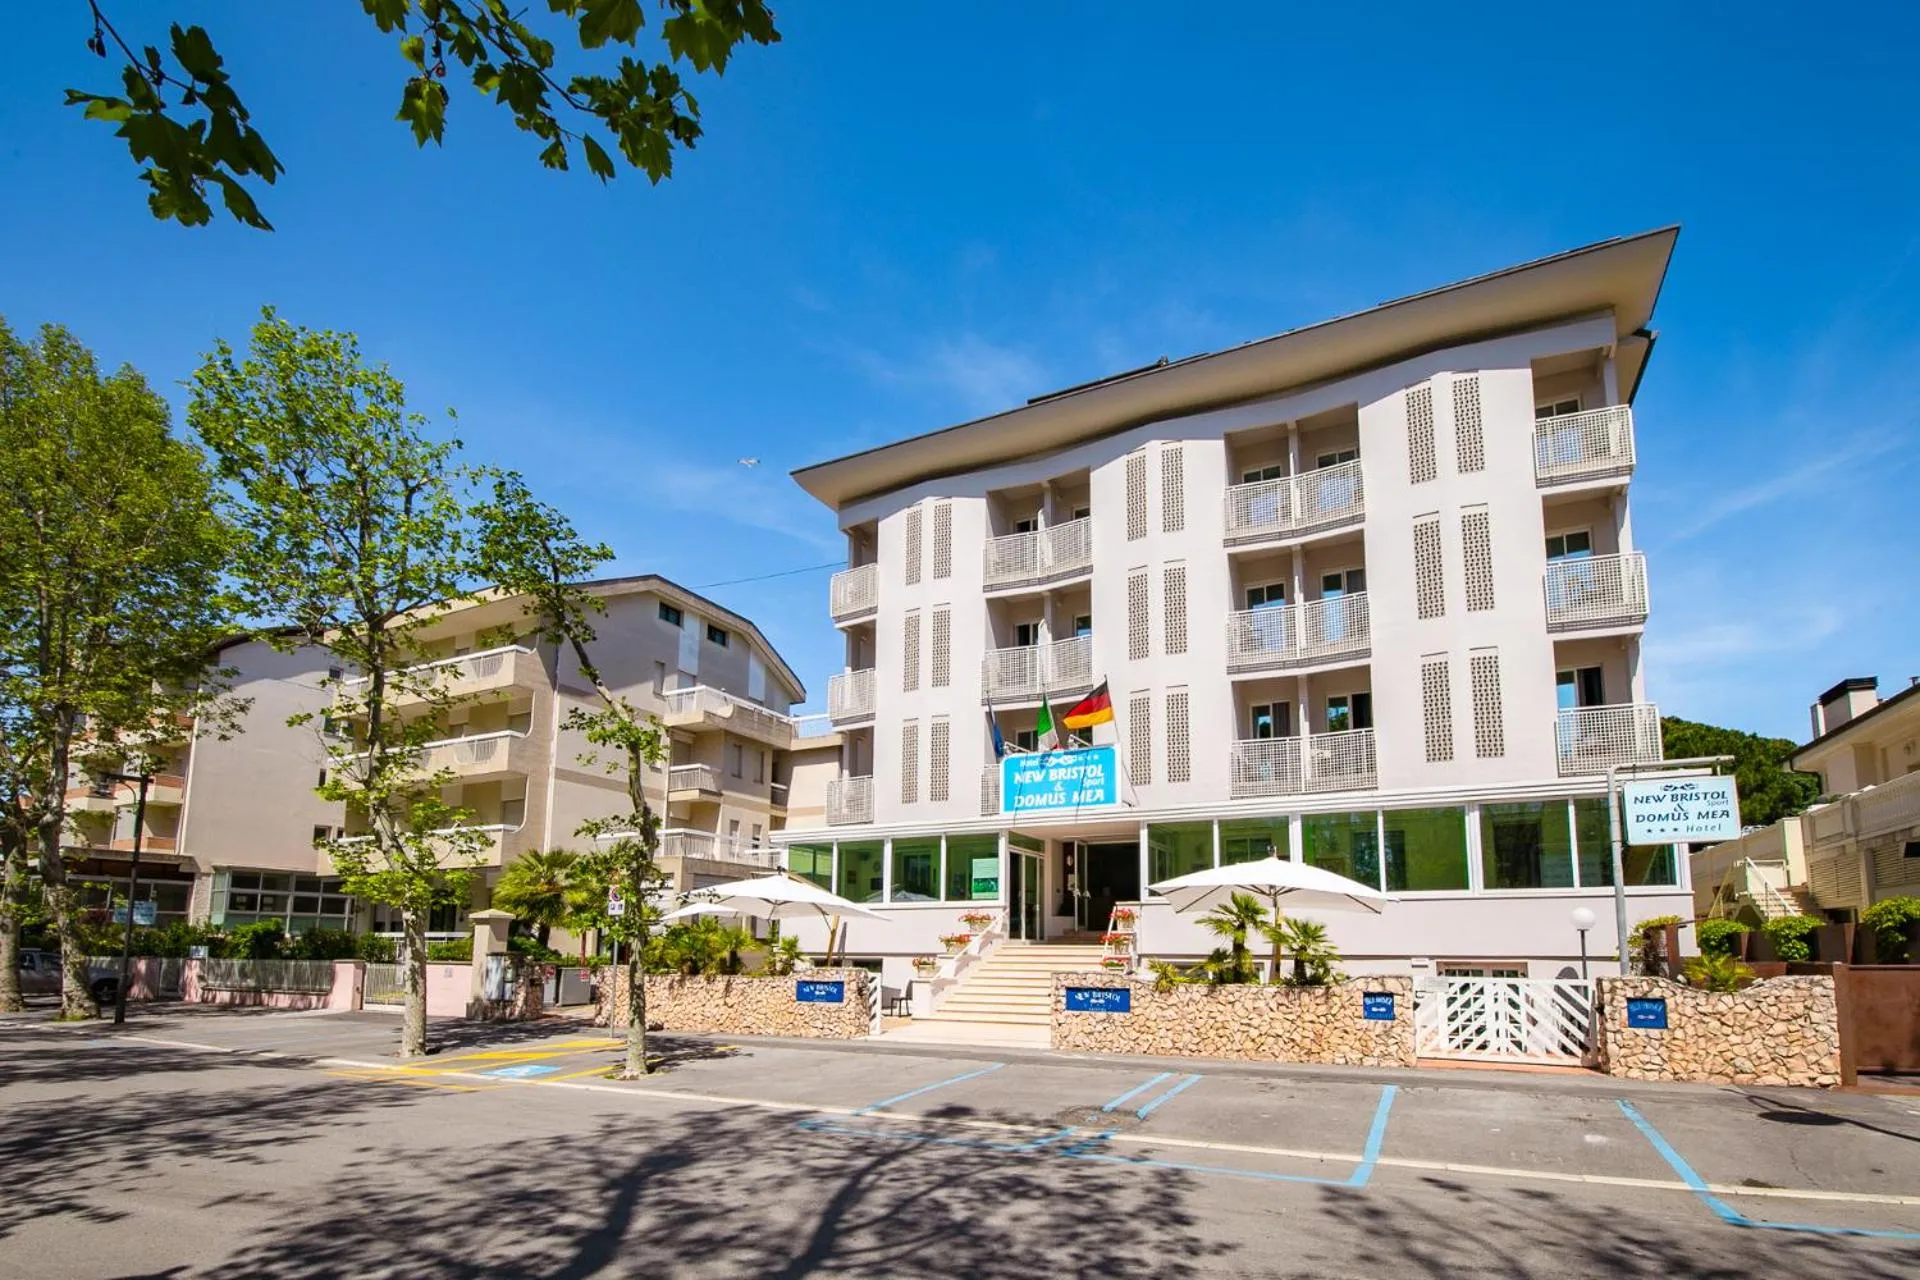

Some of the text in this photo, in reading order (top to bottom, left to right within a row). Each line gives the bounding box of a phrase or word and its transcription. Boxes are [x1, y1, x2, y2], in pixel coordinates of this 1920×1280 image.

[1014, 764, 1104, 784] NEW BRISTOL
[1054, 781, 1064, 791] &
[1014, 789, 1105, 808] DOMUS MEA
[1633, 791, 1728, 805] NEW BRISTOL
[1707, 799, 1729, 807] Sport
[1673, 802, 1685, 812] &
[1635, 809, 1730, 824] DOMUS MEA
[1686, 823, 1721, 833] Hotel
